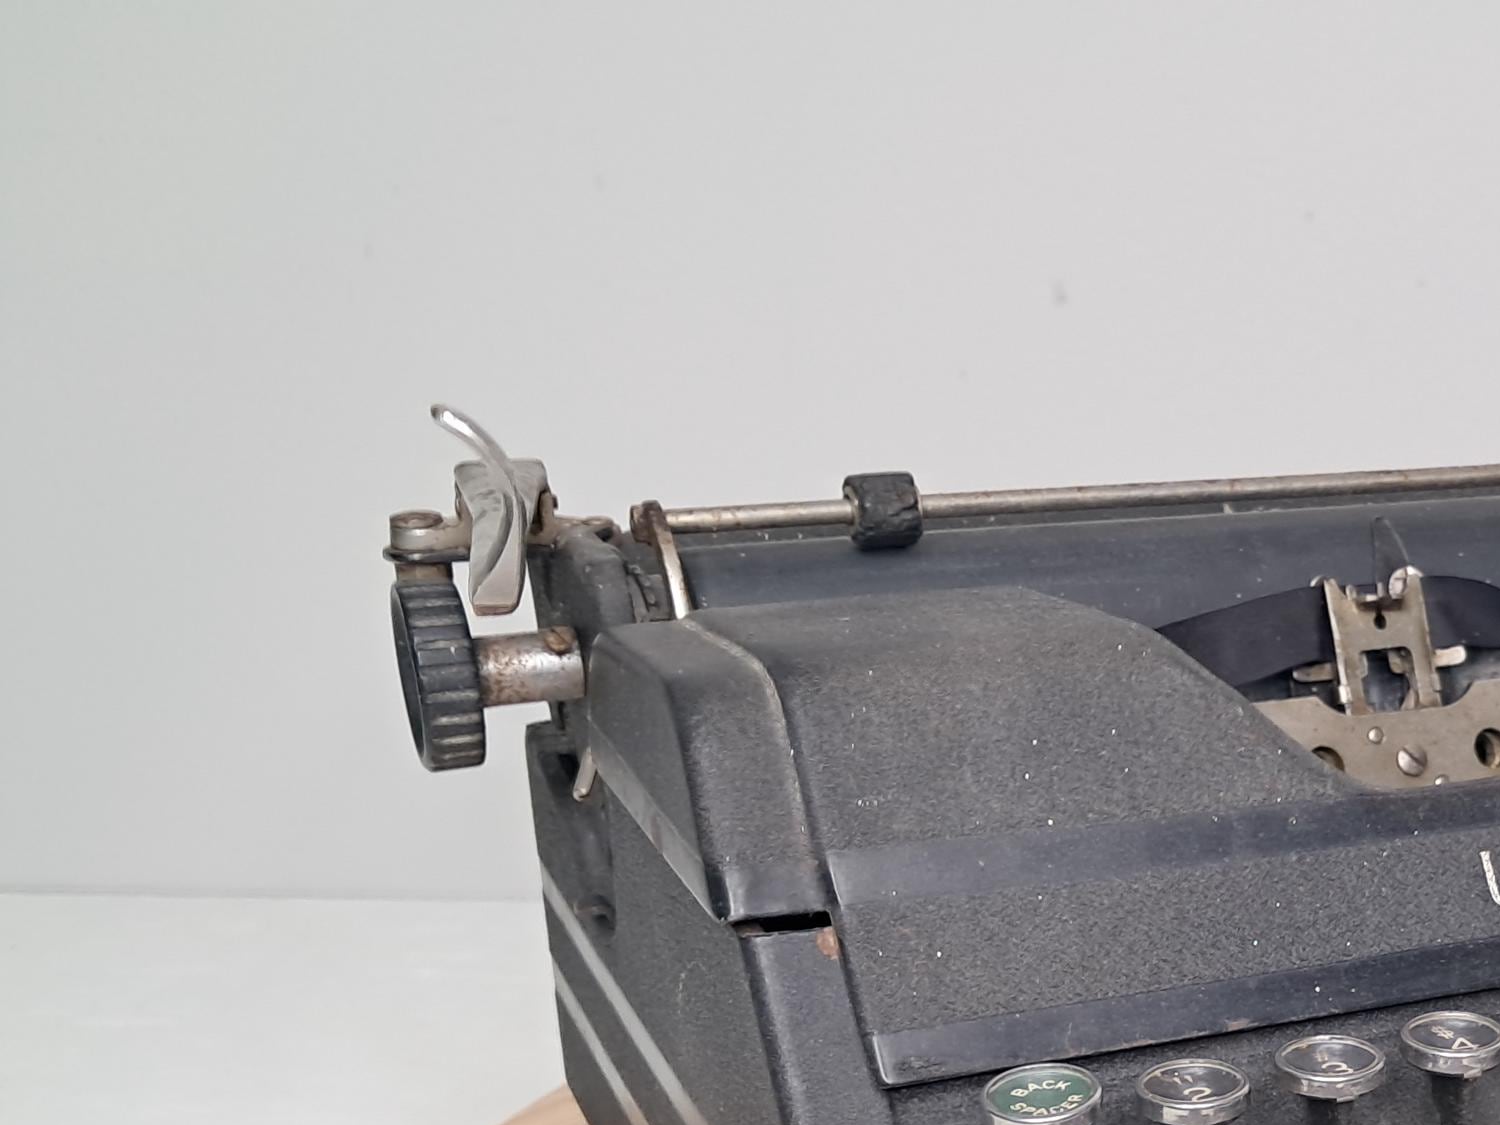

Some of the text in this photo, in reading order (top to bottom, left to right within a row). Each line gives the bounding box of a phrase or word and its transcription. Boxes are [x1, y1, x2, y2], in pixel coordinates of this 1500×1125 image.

[1452, 1037, 1480, 1050] 4
[1321, 1062, 1354, 1076] 3
[1010, 1080, 1072, 1099] BACK
[1183, 1087, 1218, 1102] 2
[1009, 1093, 1084, 1117] SPACER
